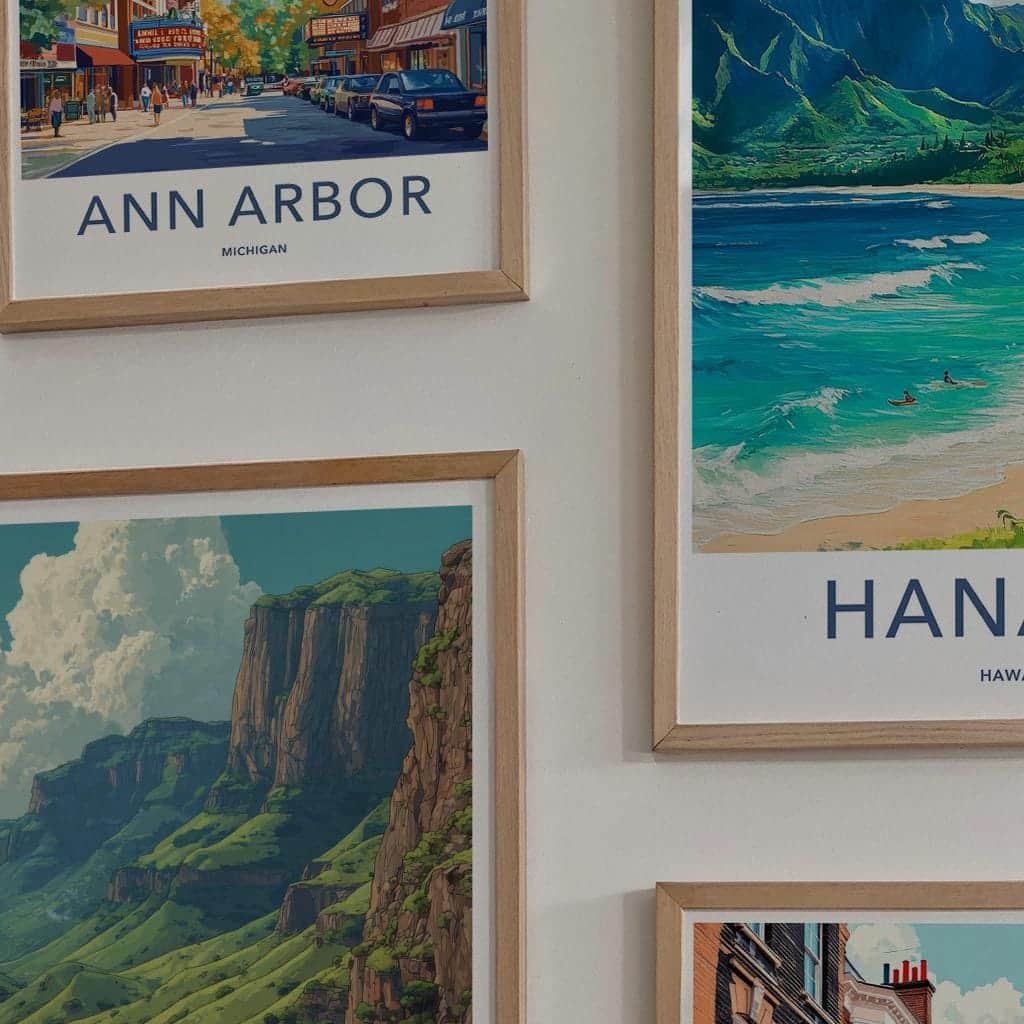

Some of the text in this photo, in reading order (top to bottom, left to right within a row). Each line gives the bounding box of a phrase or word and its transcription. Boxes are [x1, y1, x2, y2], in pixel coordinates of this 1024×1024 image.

[77, 175, 432, 236] ANN ARBOR
[221, 244, 287, 257] MICHIGAN
[827, 577, 1024, 639] HAN
[980, 668, 1024, 682] HAW
